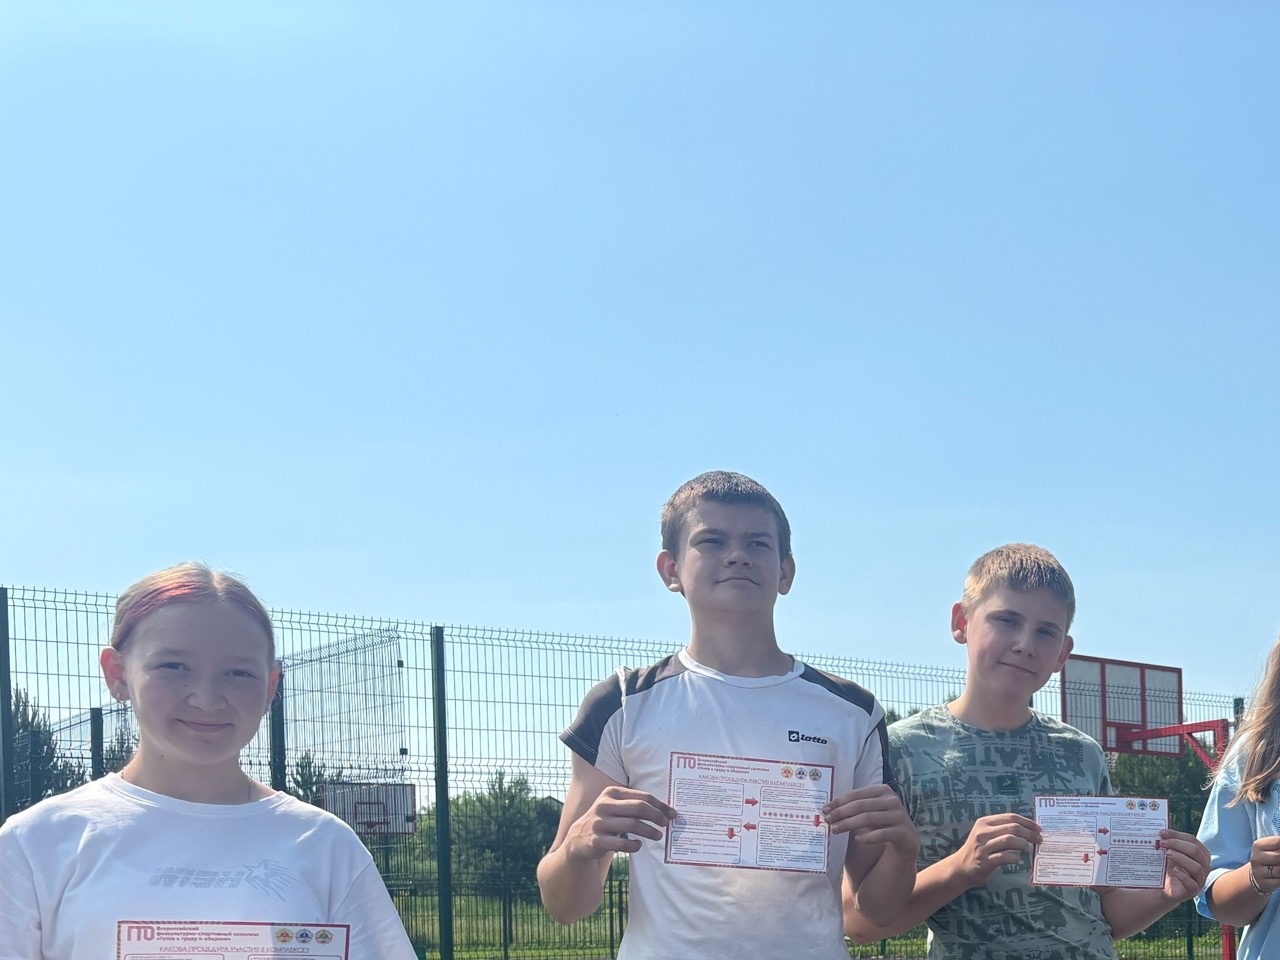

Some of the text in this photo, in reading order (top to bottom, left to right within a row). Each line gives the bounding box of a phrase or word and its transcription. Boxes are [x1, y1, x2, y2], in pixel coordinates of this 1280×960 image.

[801, 734, 828, 745] lotto
[677, 756, 696, 769] ГТО
[1039, 798, 1055, 808] ГТО
[127, 925, 155, 941] ГТО
